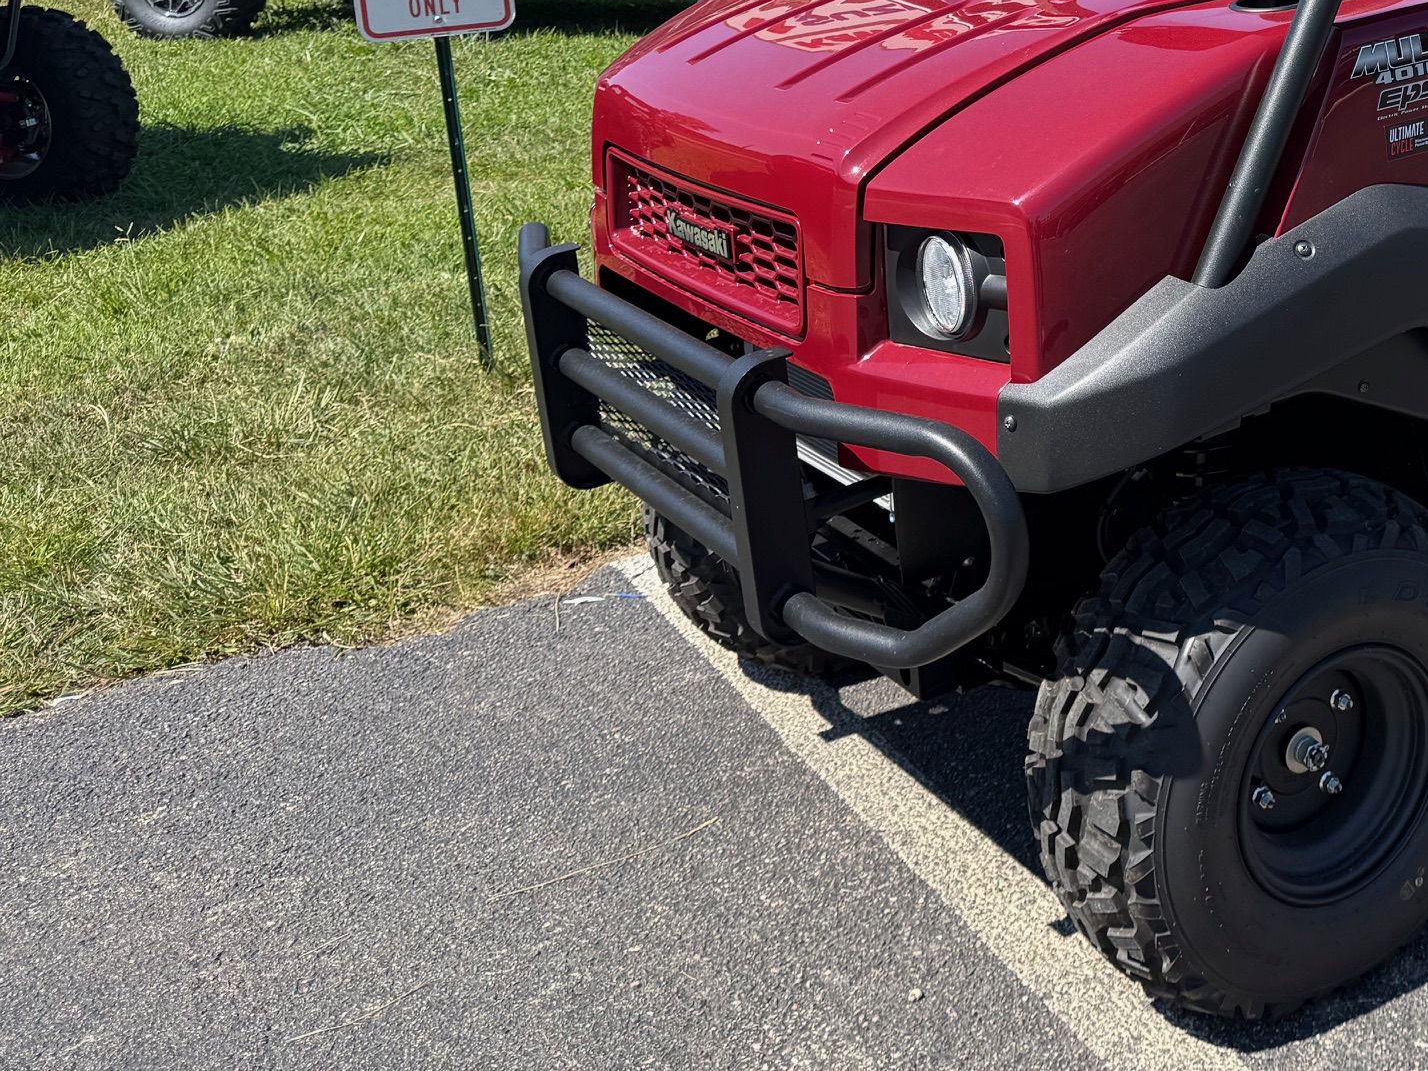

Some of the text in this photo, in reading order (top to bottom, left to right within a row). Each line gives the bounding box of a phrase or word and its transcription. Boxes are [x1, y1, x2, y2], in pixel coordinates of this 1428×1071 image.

[1400, 106, 1419, 115] Power
[1389, 121, 1425, 143] ULTIMATE
[1391, 138, 1414, 156] CYCLE
[667, 209, 729, 259] Kawasaki
